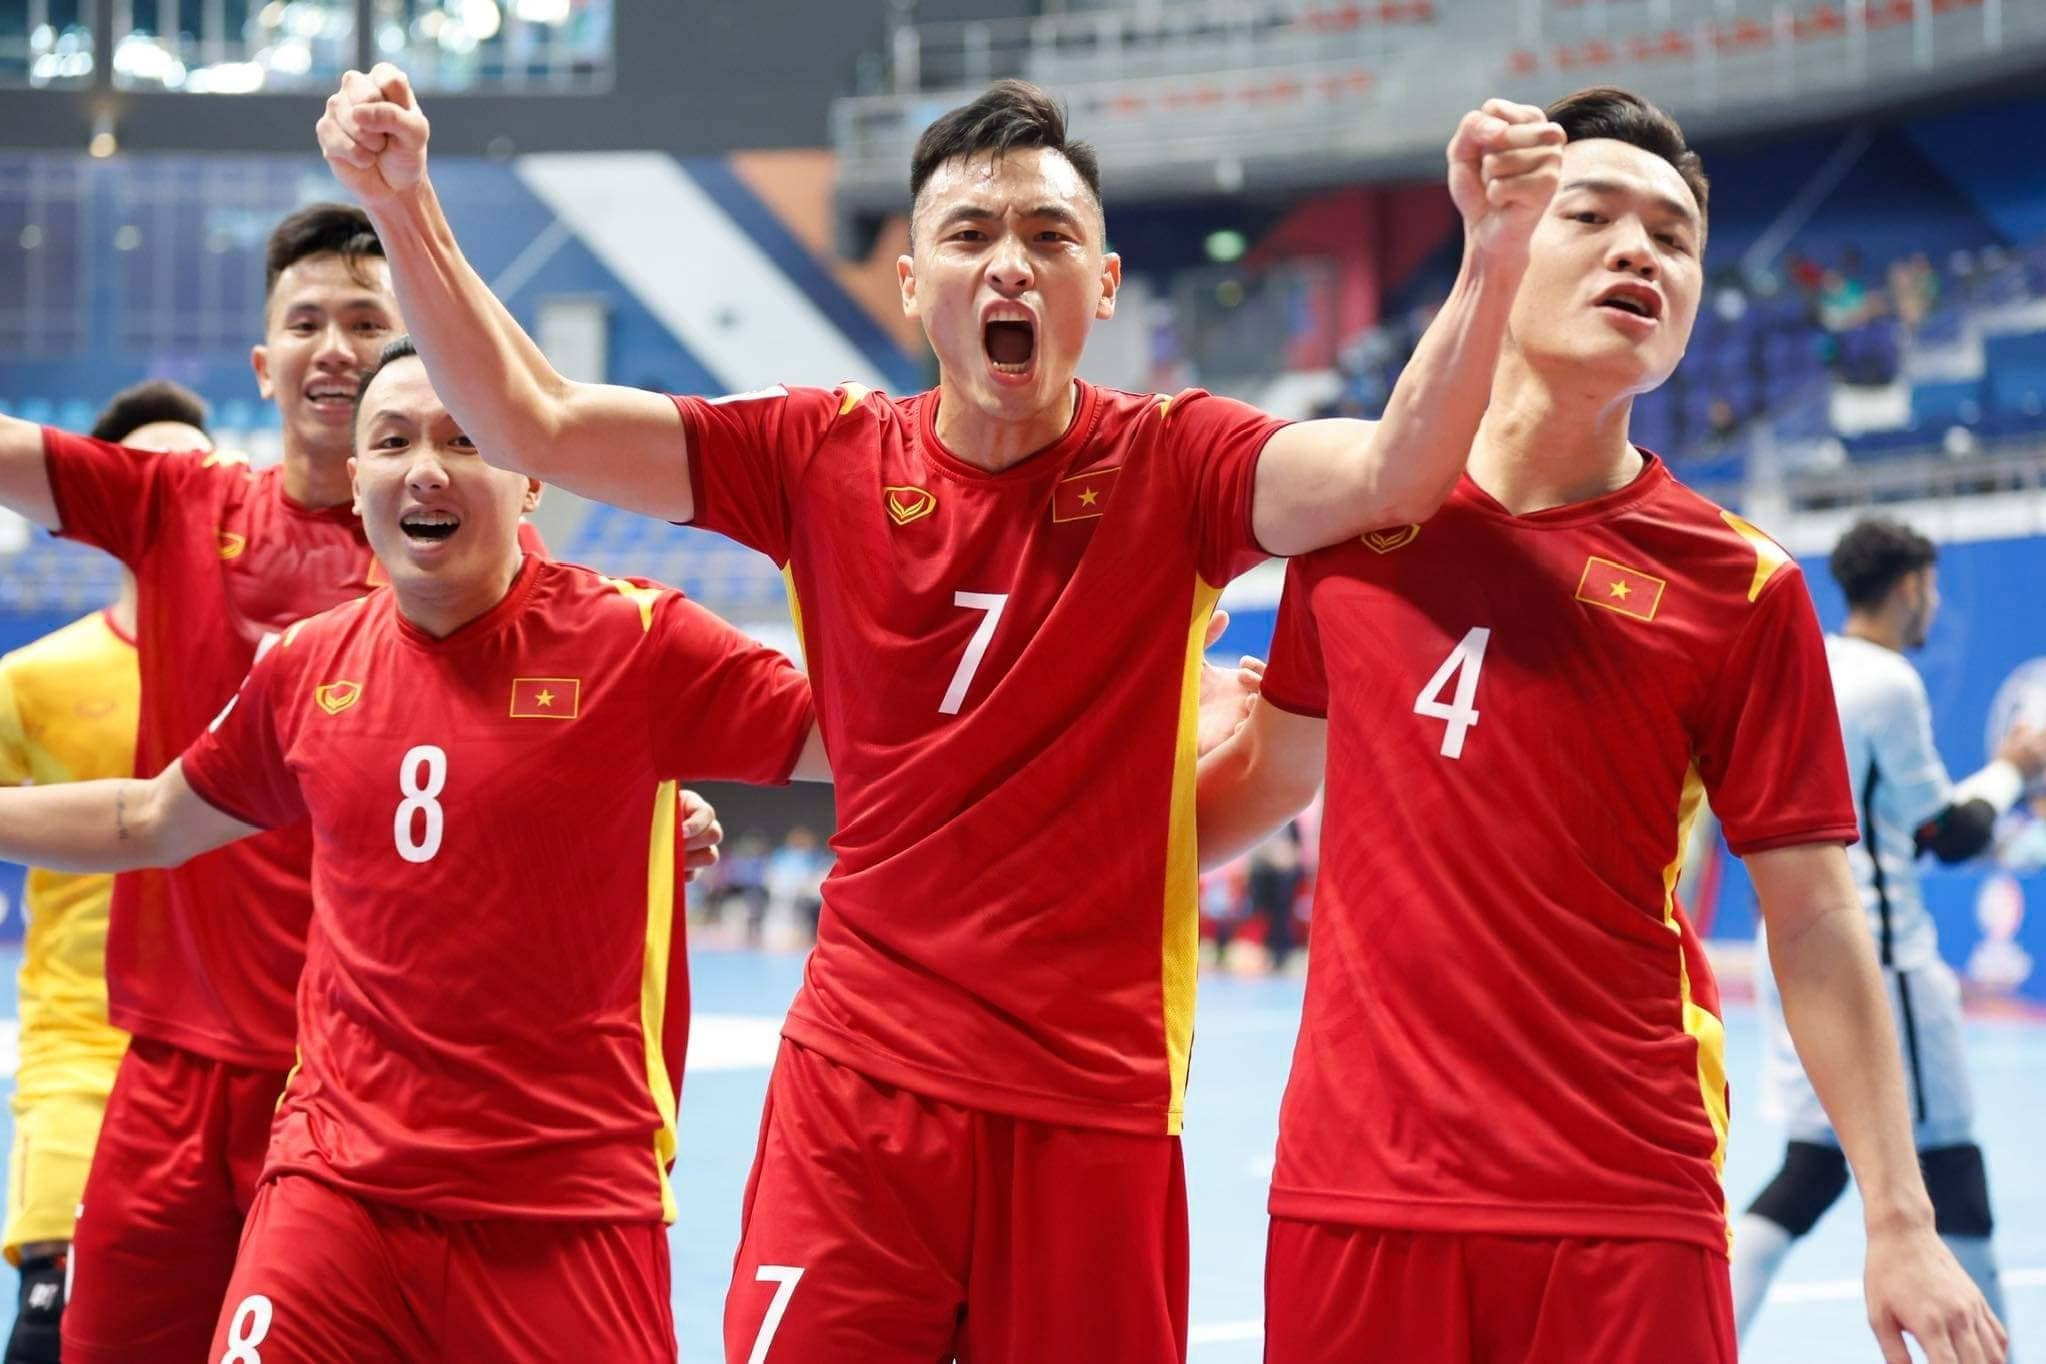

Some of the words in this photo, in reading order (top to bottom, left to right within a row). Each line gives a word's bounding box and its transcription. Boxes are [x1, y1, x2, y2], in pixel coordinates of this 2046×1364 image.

[938, 591, 1009, 715] 7
[1413, 627, 1490, 759] 4
[394, 744, 448, 863] 8
[219, 1294, 273, 1364] 8
[747, 1264, 806, 1364] 7
